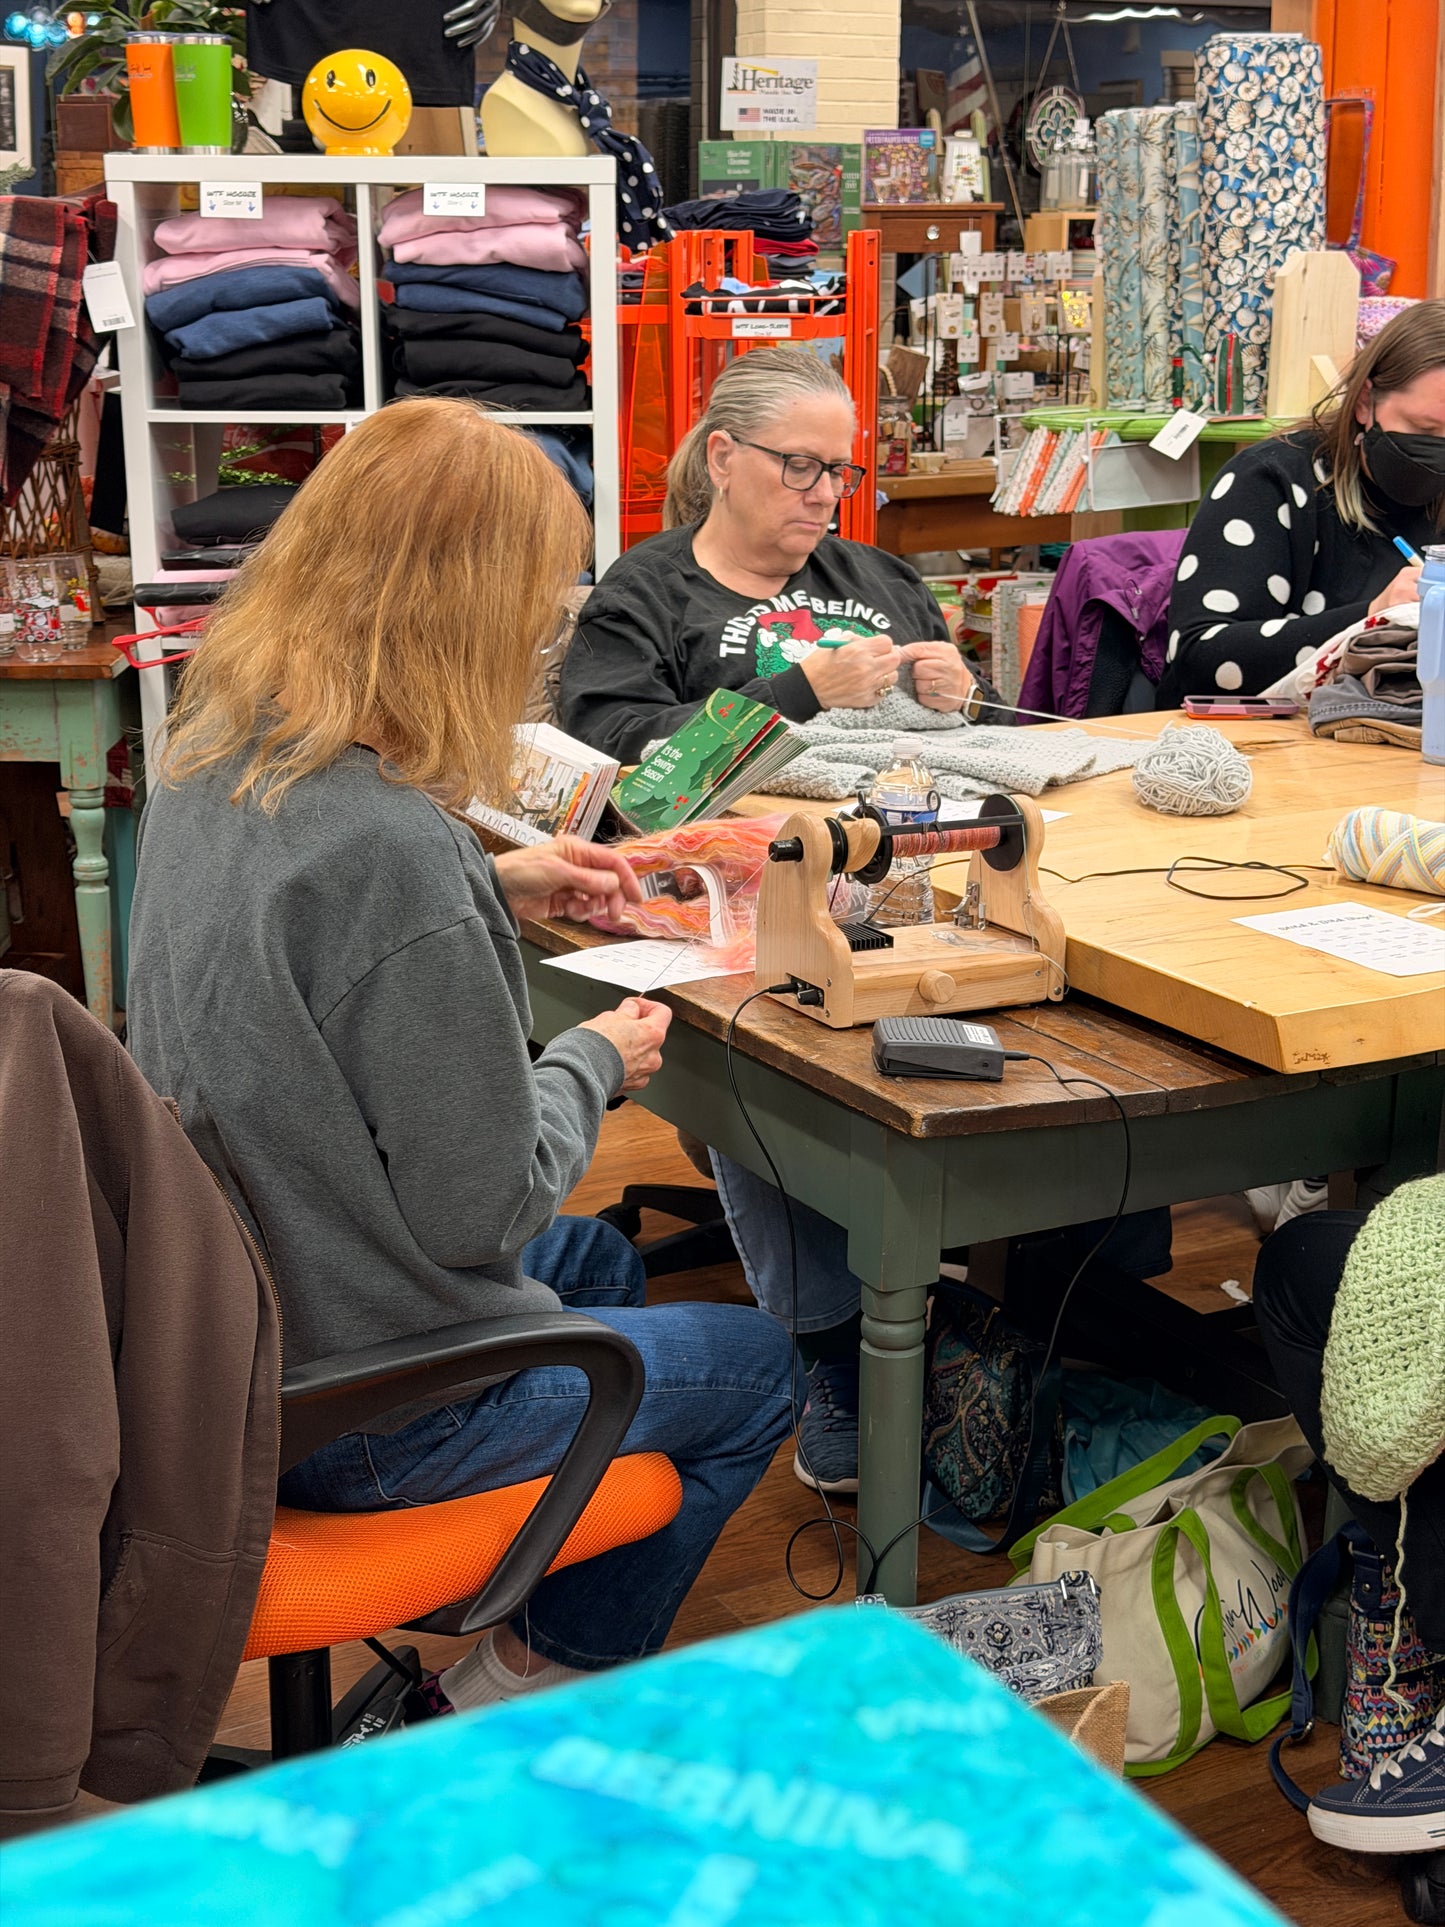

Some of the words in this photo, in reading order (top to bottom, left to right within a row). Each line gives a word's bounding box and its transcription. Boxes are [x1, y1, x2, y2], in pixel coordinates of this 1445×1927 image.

[741, 69, 815, 94] Heritage
[769, 589, 811, 613] ME
[810, 597, 892, 630] BEING
[650, 754, 676, 775] Sewing
[669, 747, 684, 761] the
[640, 765, 665, 783] Season
